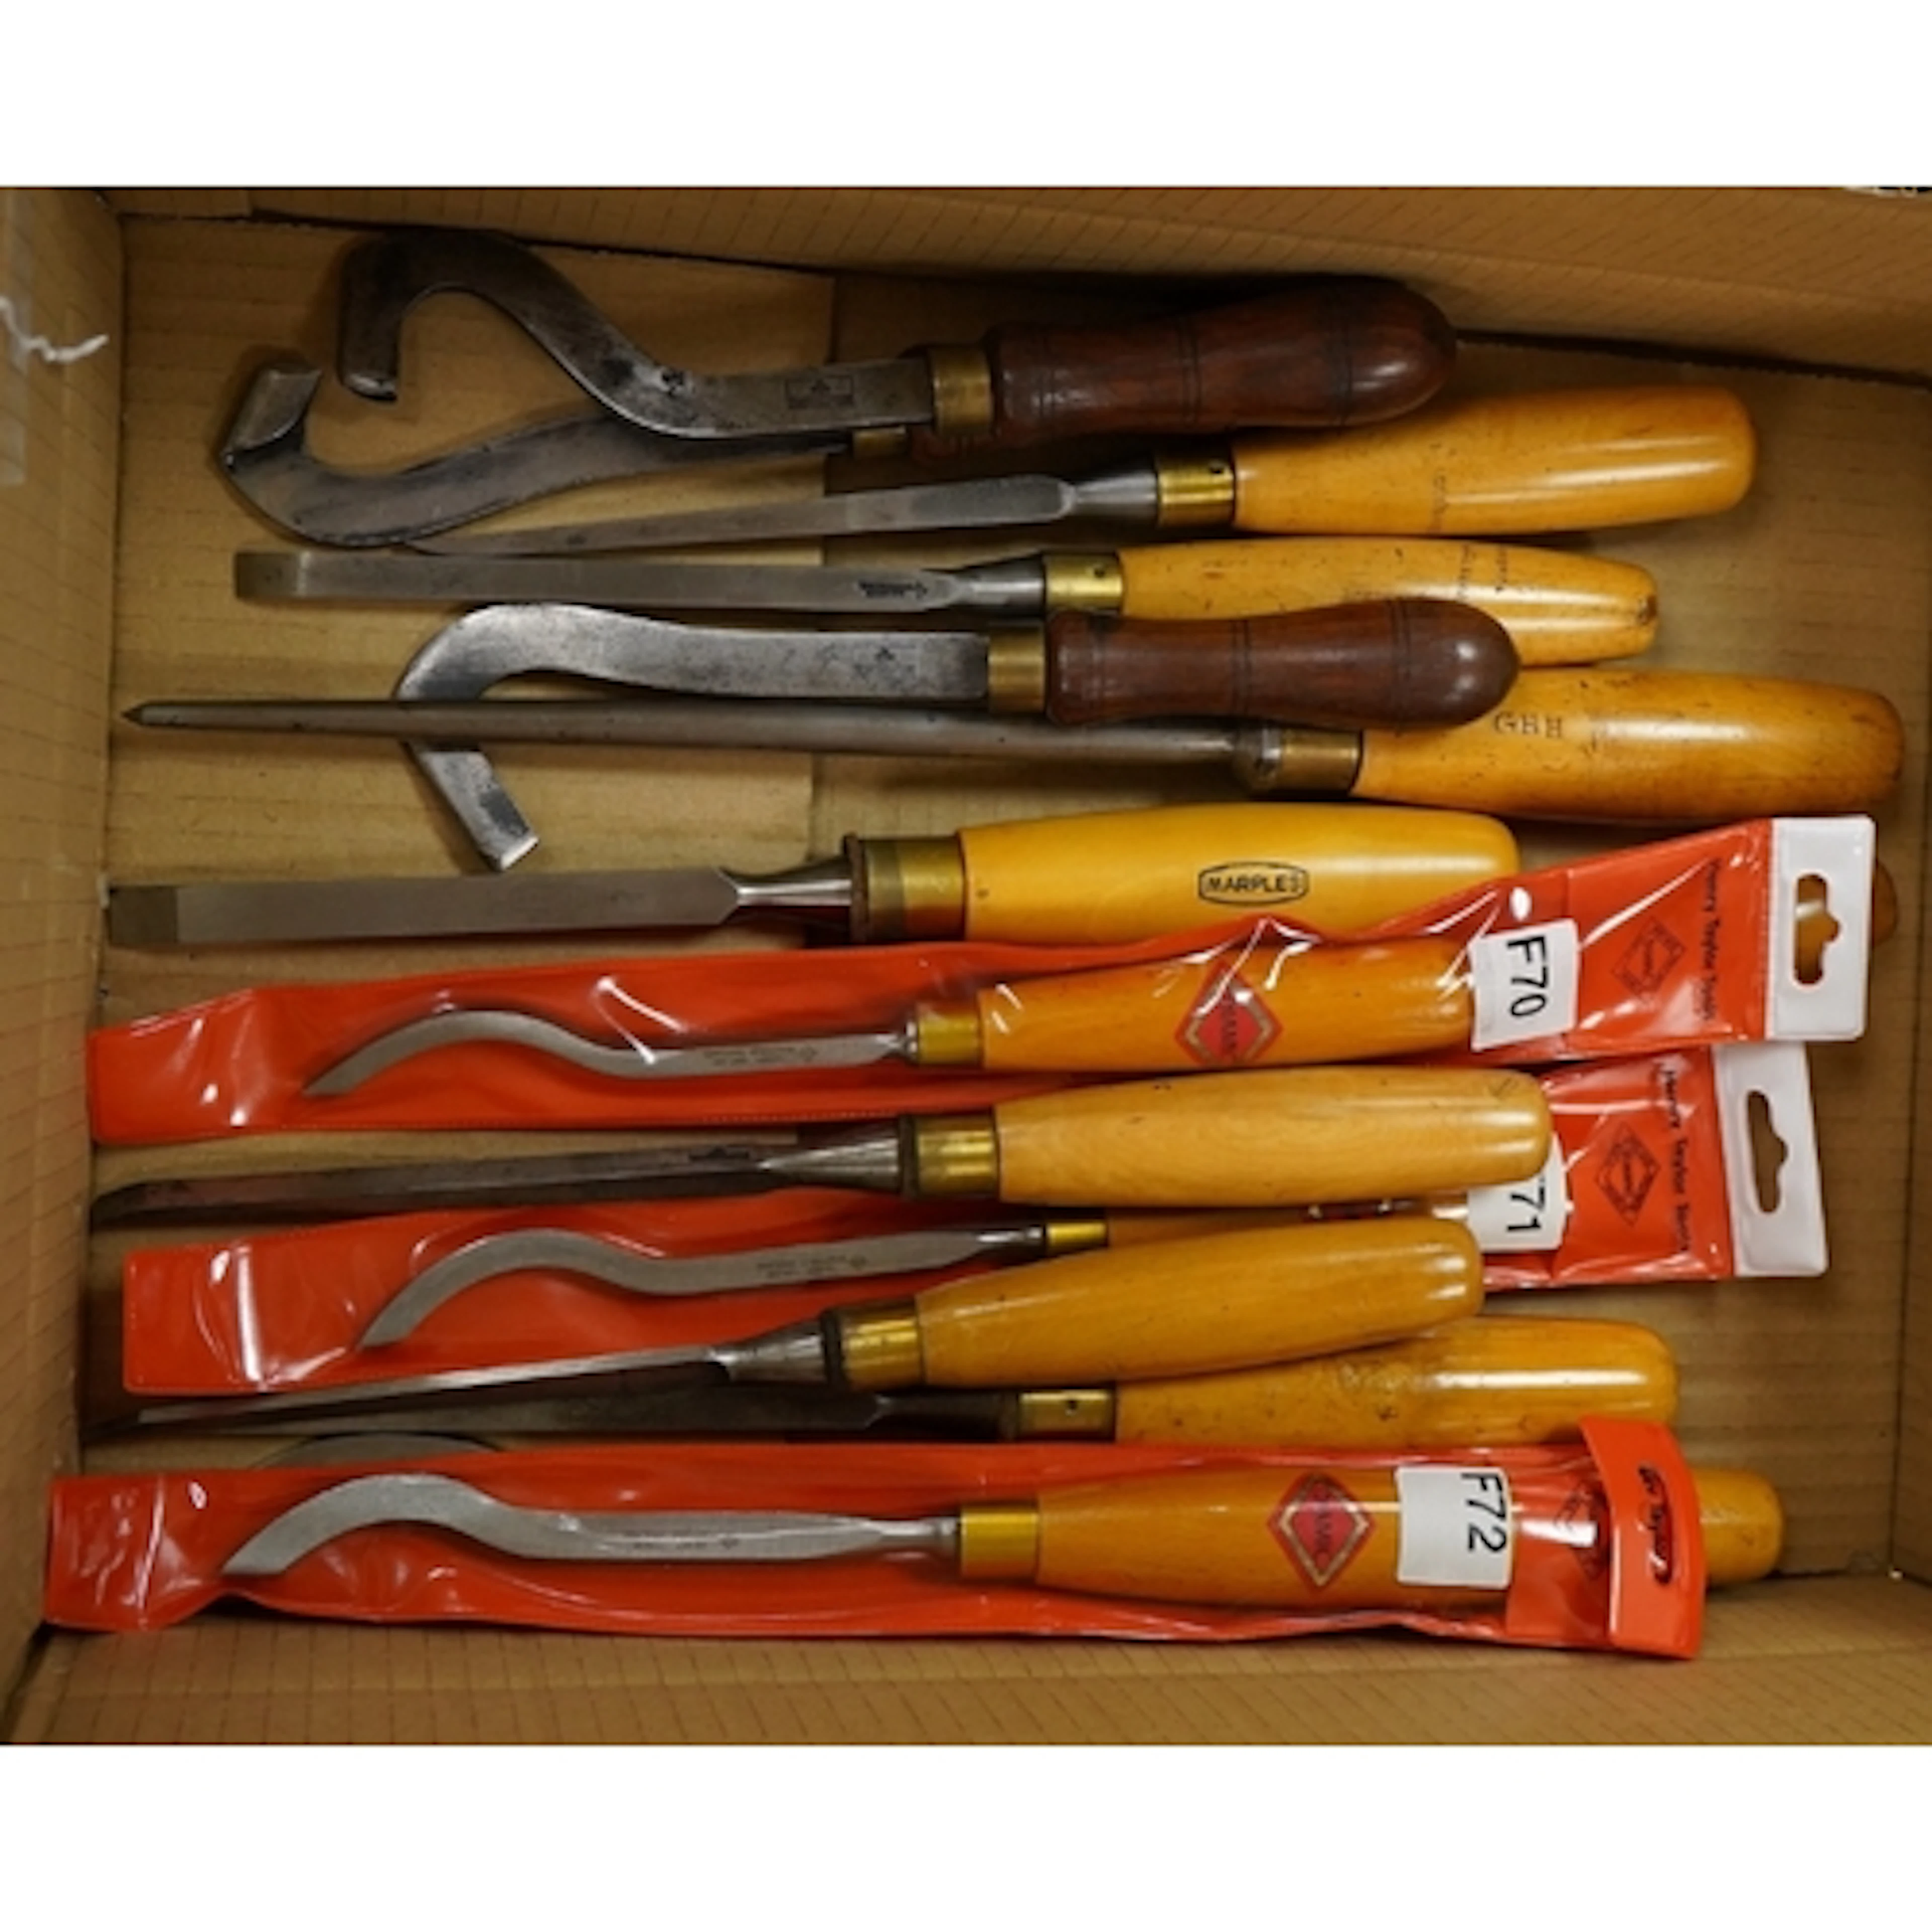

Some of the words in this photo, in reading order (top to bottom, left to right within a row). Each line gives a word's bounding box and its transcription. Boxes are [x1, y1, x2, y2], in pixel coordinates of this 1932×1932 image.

[1507, 936, 1547, 1016] F70
[1507, 1176, 1545, 1231] 71
[1461, 1473, 1507, 1552] F72
